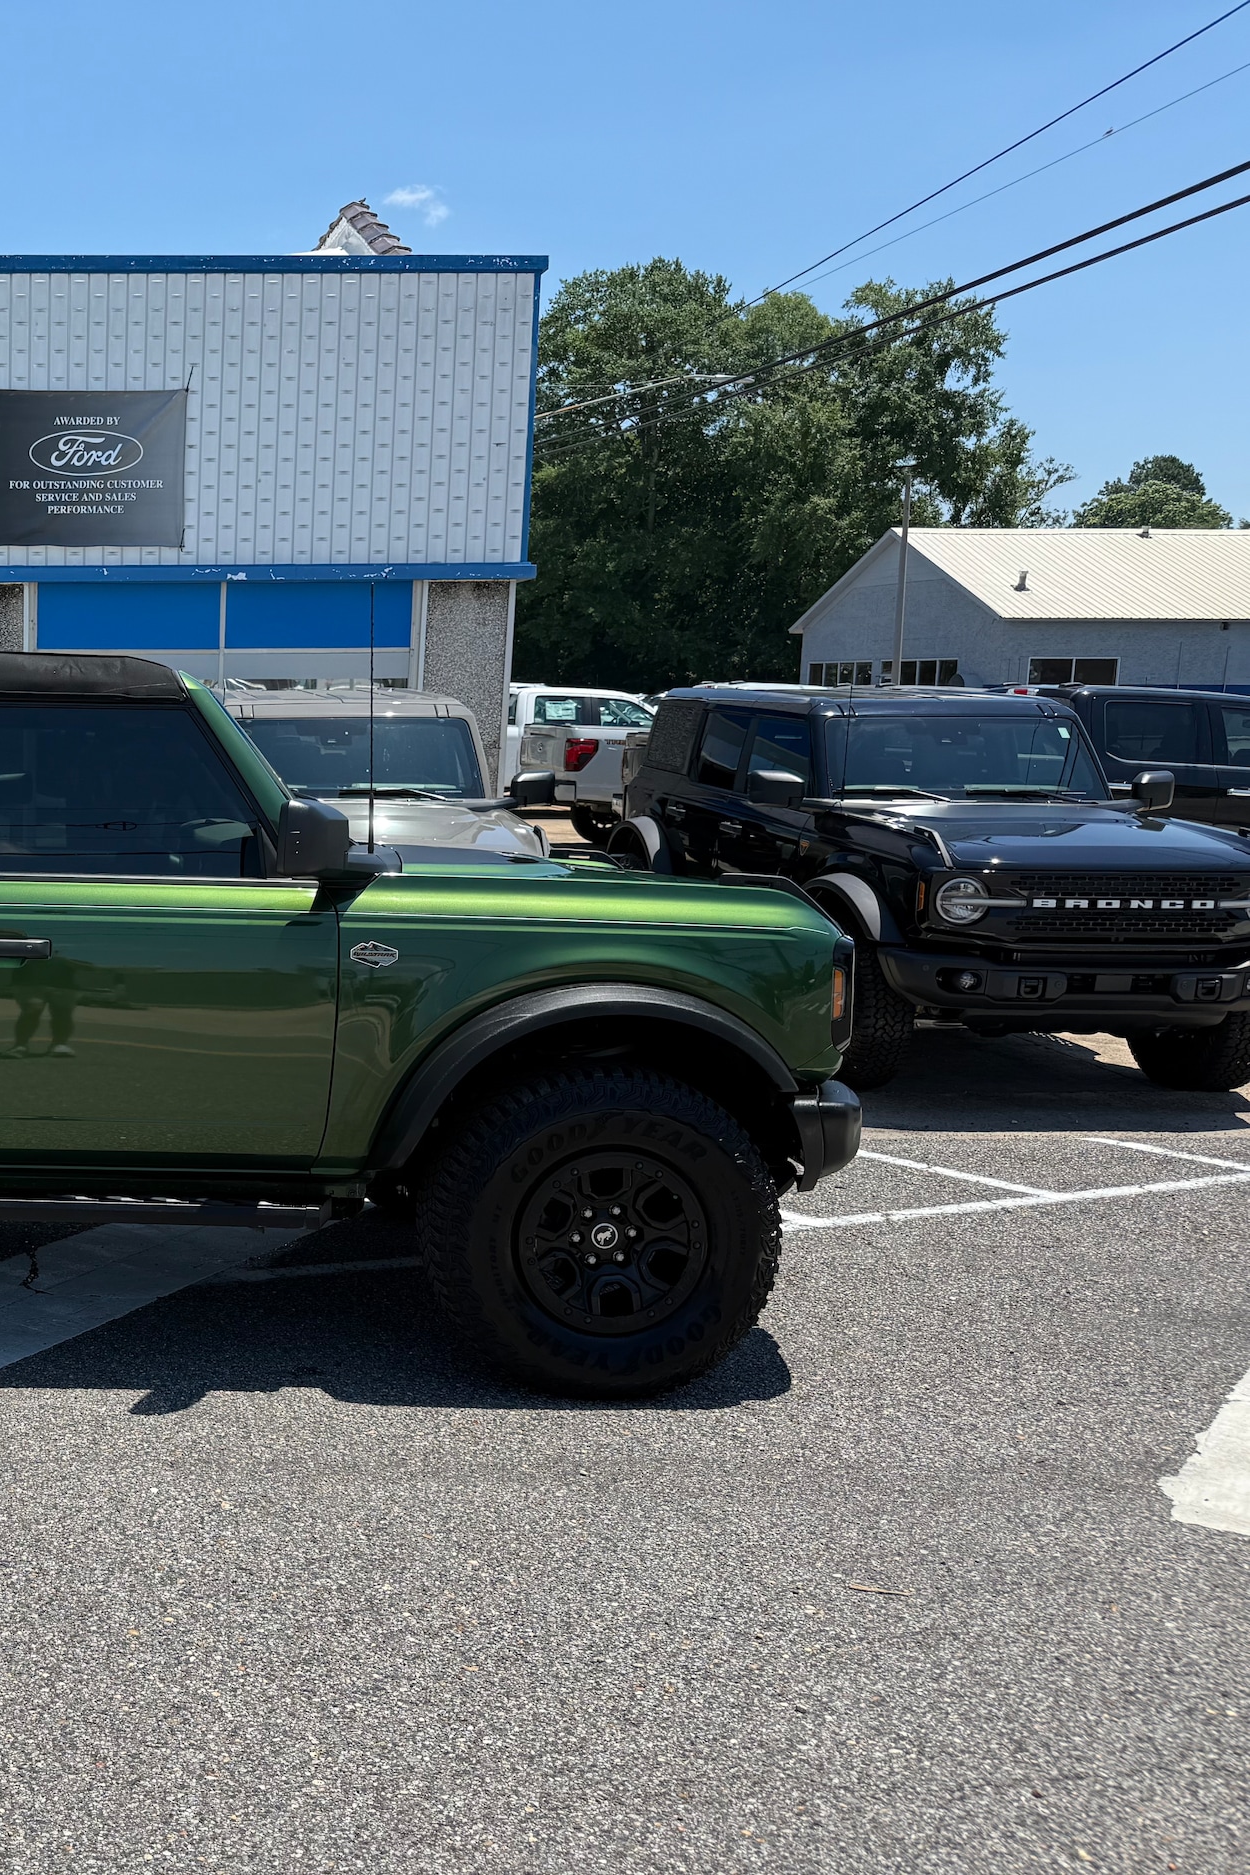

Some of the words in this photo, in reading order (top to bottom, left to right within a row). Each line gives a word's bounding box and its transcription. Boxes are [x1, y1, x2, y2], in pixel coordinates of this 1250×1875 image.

[53, 416, 103, 425] AWARDED
[106, 416, 121, 425] BY
[50, 435, 123, 467] Ford
[9, 480, 30, 490] FOR
[32, 480, 104, 490] OUTSTANDING
[106, 479, 164, 489] CUSTOMER
[35, 492, 79, 502] SERVICE
[81, 492, 102, 501] AND
[105, 492, 137, 501] SALES
[47, 505, 125, 514] PERFORMANCE
[1032, 898, 1215, 910] BRONCO
[511, 1111, 708, 1183] GOODYEAR
